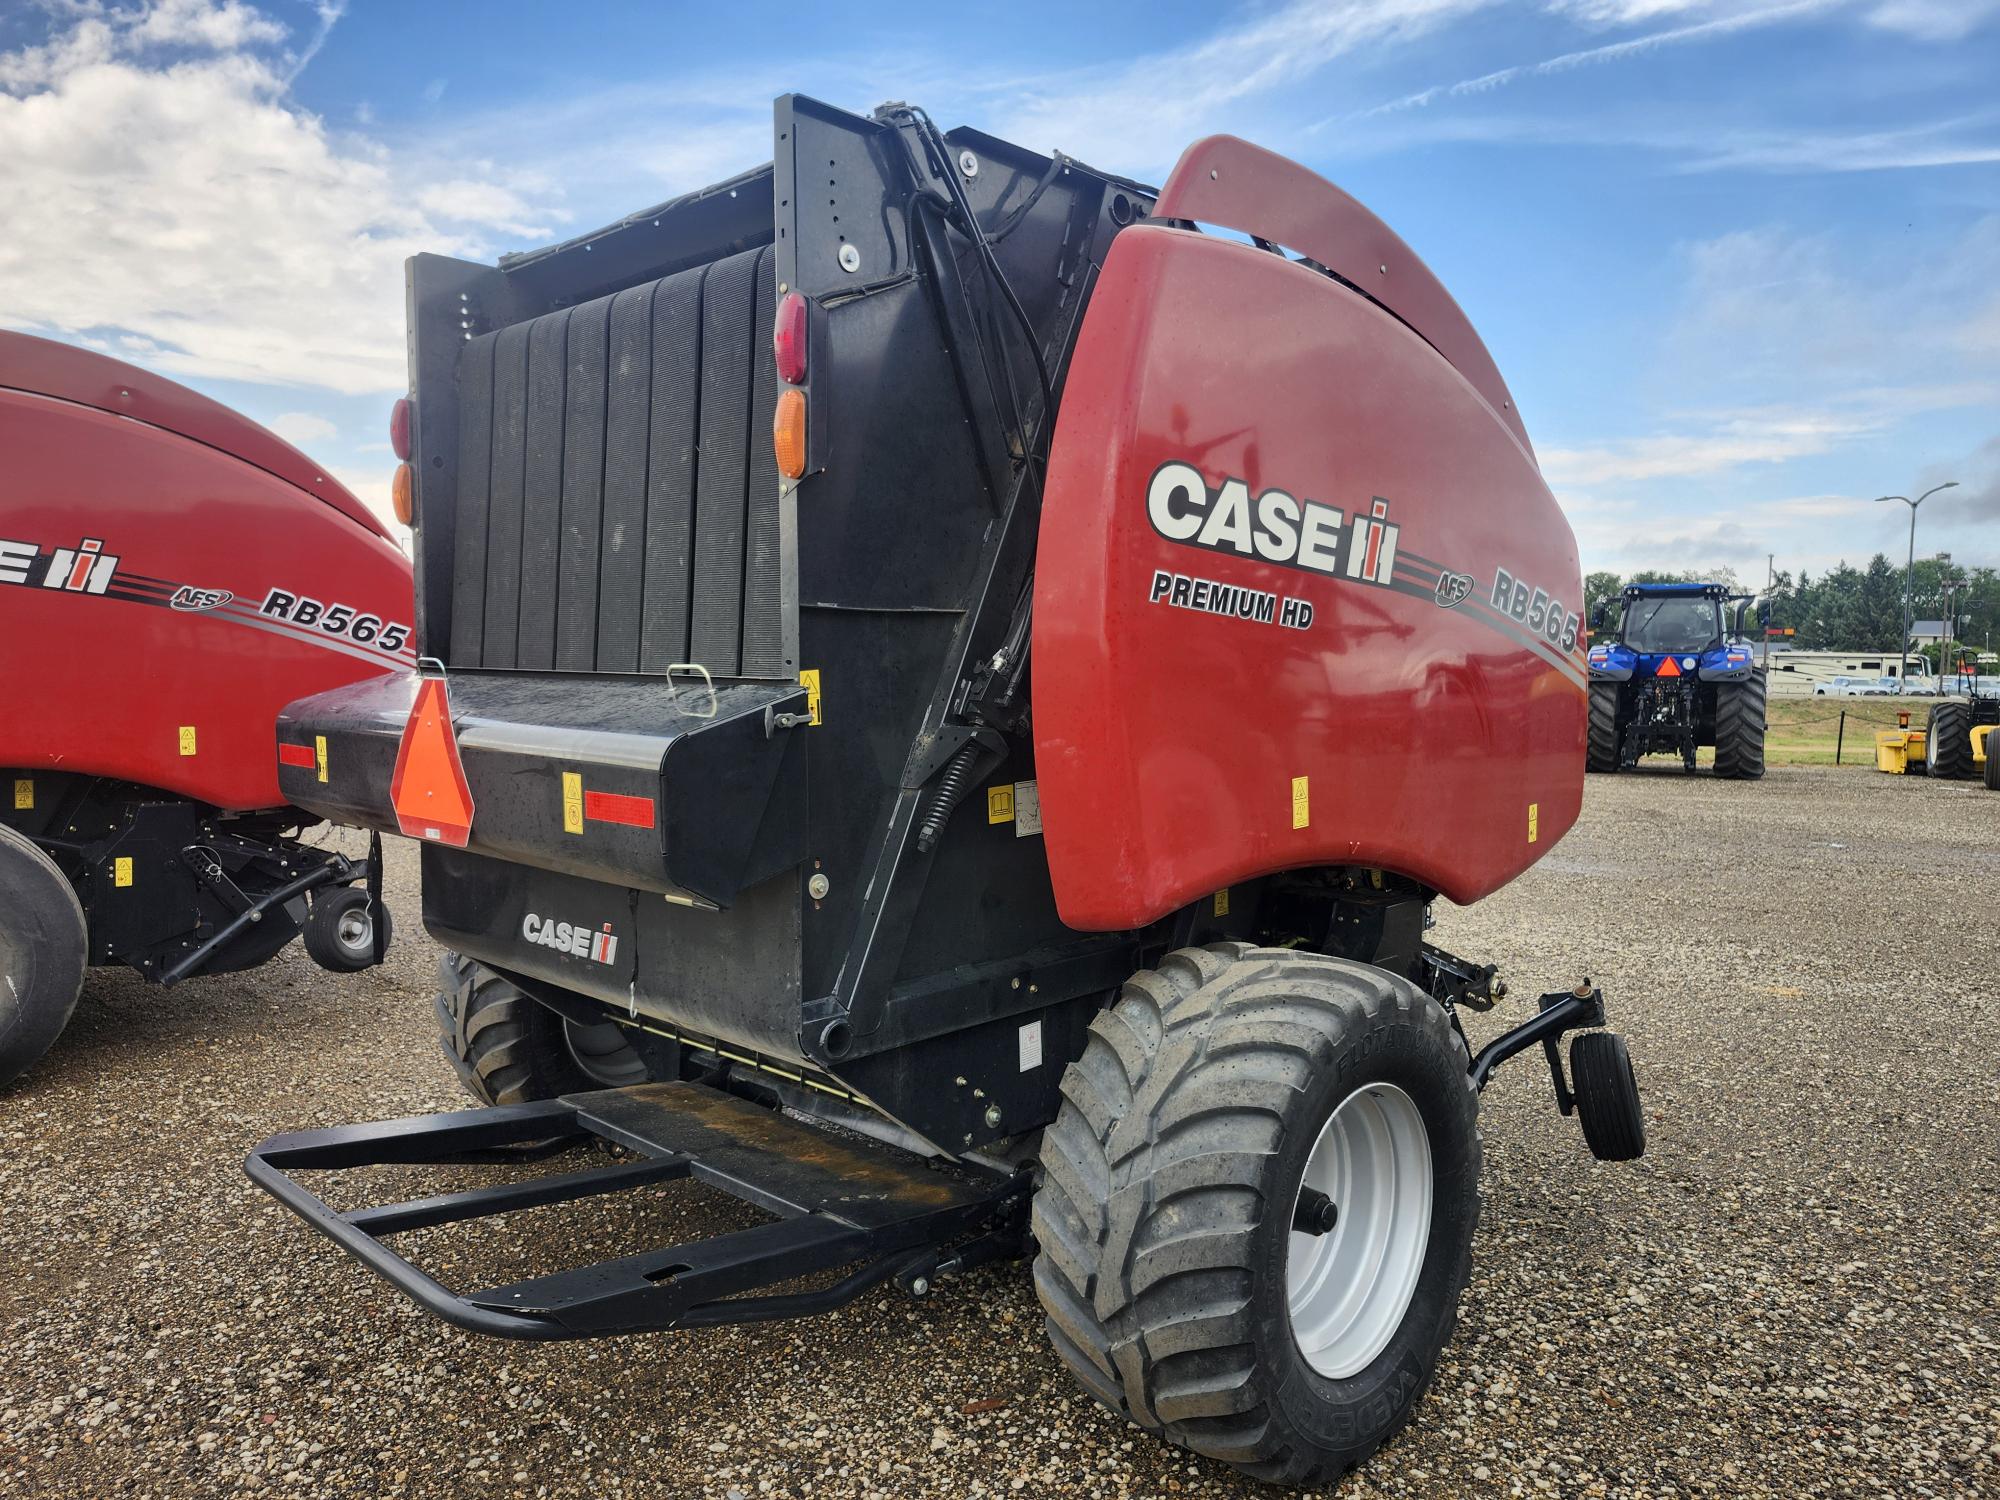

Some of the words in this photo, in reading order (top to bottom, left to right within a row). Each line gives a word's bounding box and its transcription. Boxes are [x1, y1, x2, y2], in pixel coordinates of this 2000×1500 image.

[1149, 464, 1343, 572] CASE
[172, 586, 219, 608] AFS
[1149, 570, 1277, 624] PREMIUM
[1279, 597, 1313, 630] HD
[1436, 572, 1466, 601] AFS
[1491, 567, 1579, 655] RB565
[260, 588, 410, 652] RB565
[523, 913, 591, 958] CASE
